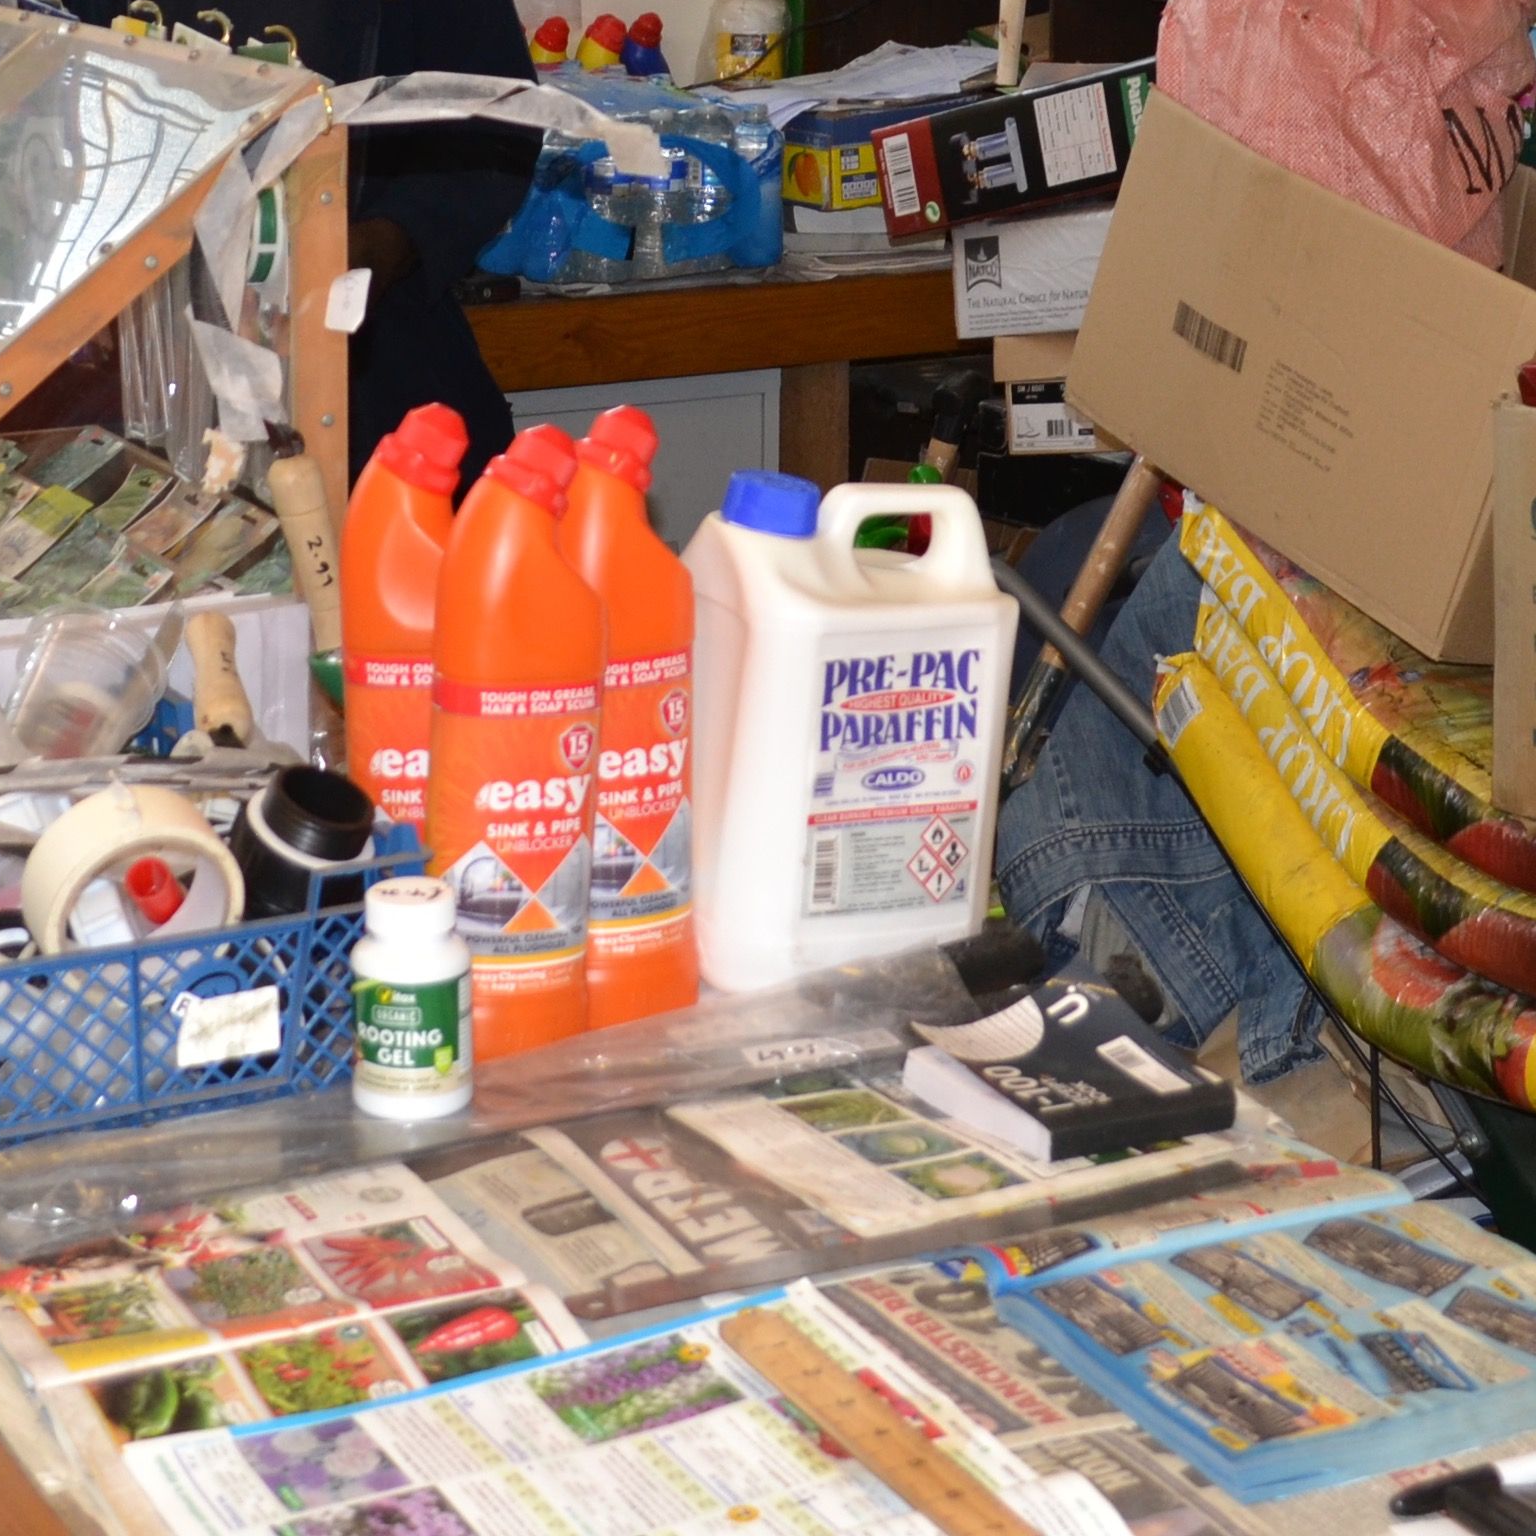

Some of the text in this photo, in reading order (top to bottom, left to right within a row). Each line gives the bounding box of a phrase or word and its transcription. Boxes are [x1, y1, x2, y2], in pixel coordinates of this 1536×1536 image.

[966, 291, 1048, 309] THE NATURAL CHOICE
[365, 661, 435, 674] TOUGH ON
[634, 670, 662, 685] SOAP
[821, 648, 981, 708] PRE-PAC
[480, 685, 596, 703] TOUGH ON GREASE
[847, 690, 946, 710] HIGHEST QUALITY
[481, 697, 596, 714] HAIR & SOAP SCUM
[669, 700, 685, 720] 15
[819, 698, 978, 753] PARAFFIN
[568, 735, 589, 757] 15
[597, 737, 688, 782] easy
[864, 769, 923, 789] CALDO
[489, 773, 593, 813] easy
[598, 780, 683, 806] SINK & PIPE
[609, 797, 677, 819] UNBLOCKER
[486, 816, 581, 839] SINK & PIPE
[496, 833, 574, 853] UNBLOCKER
[376, 1046, 416, 1066] GEL
